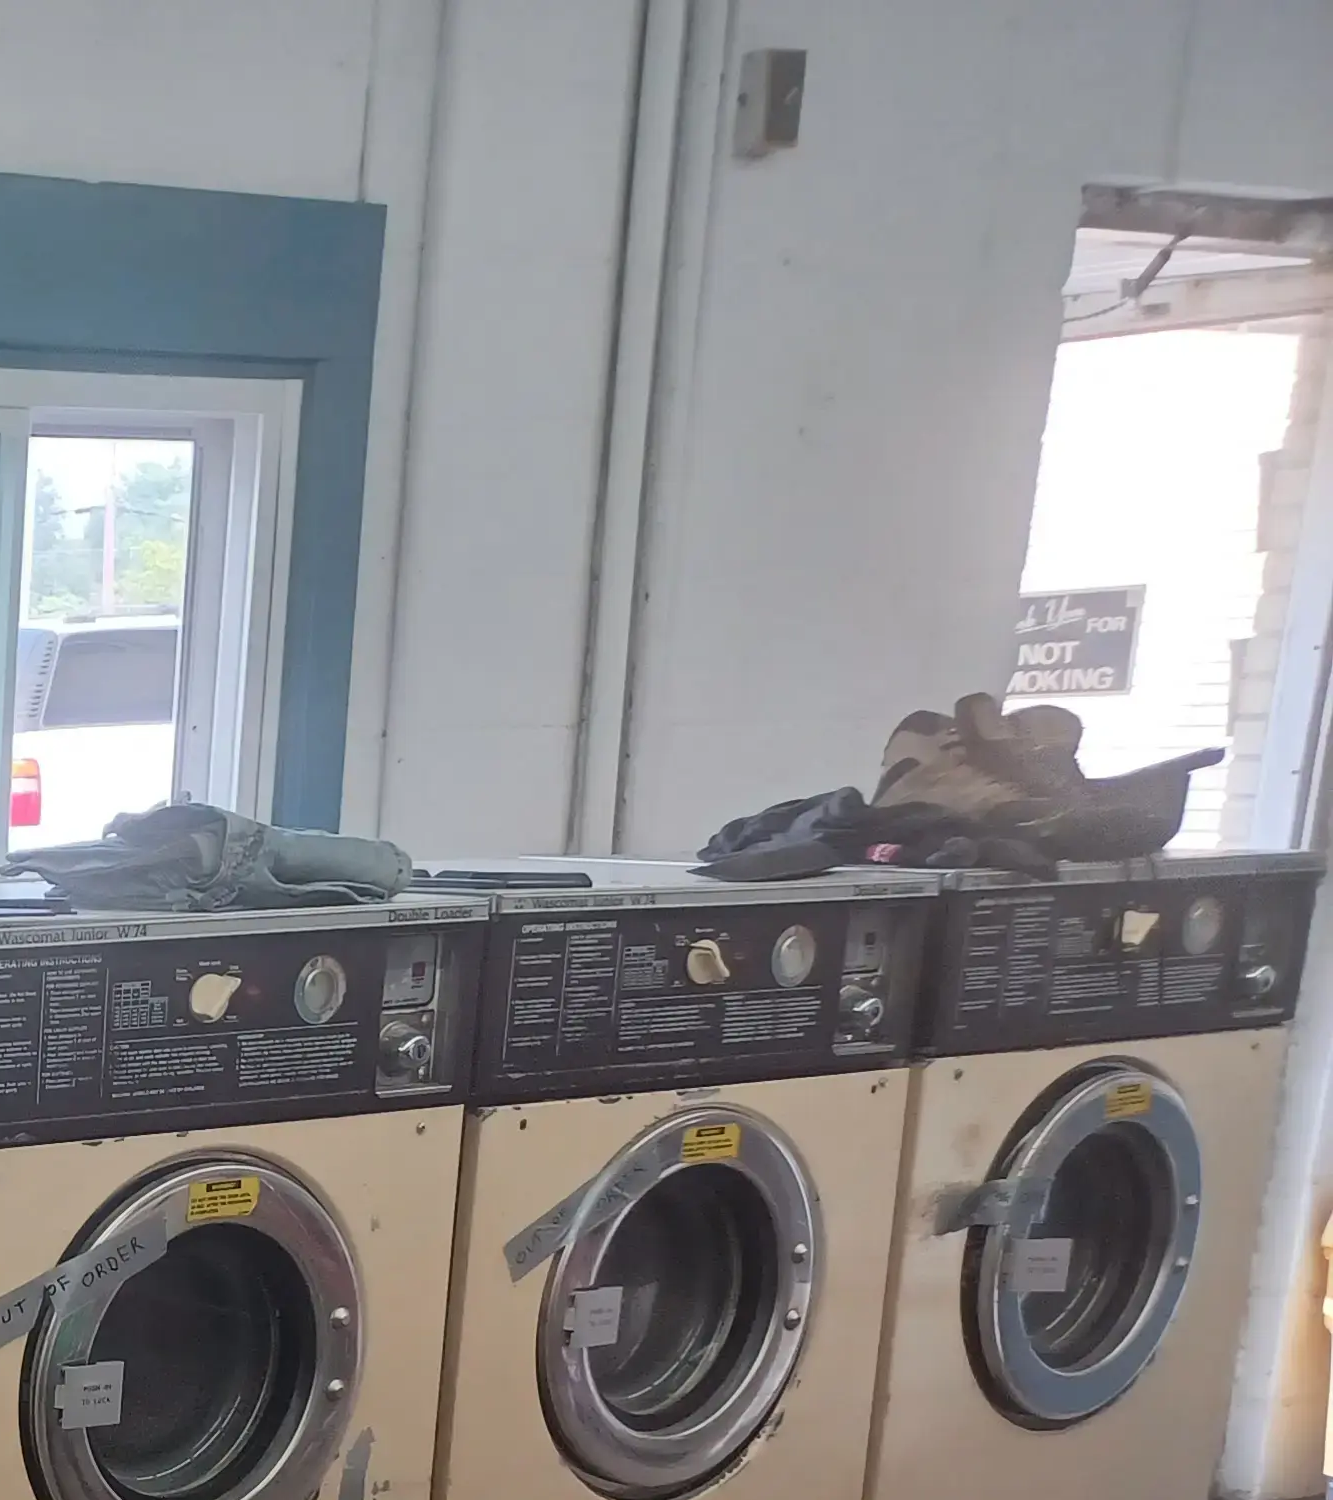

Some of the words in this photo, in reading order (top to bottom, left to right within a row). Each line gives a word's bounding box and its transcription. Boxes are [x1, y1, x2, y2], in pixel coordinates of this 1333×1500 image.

[1085, 616, 1128, 633] FOR
[1017, 640, 1081, 667] NOT
[388, 908, 430, 923] Double
[434, 907, 474, 920] Loader
[71, 928, 110, 942] Junior
[117, 926, 132, 939] W
[134, 924, 148, 938] 74
[46, 1274, 71, 1297] OF
[81, 1236, 146, 1288] ORDER
